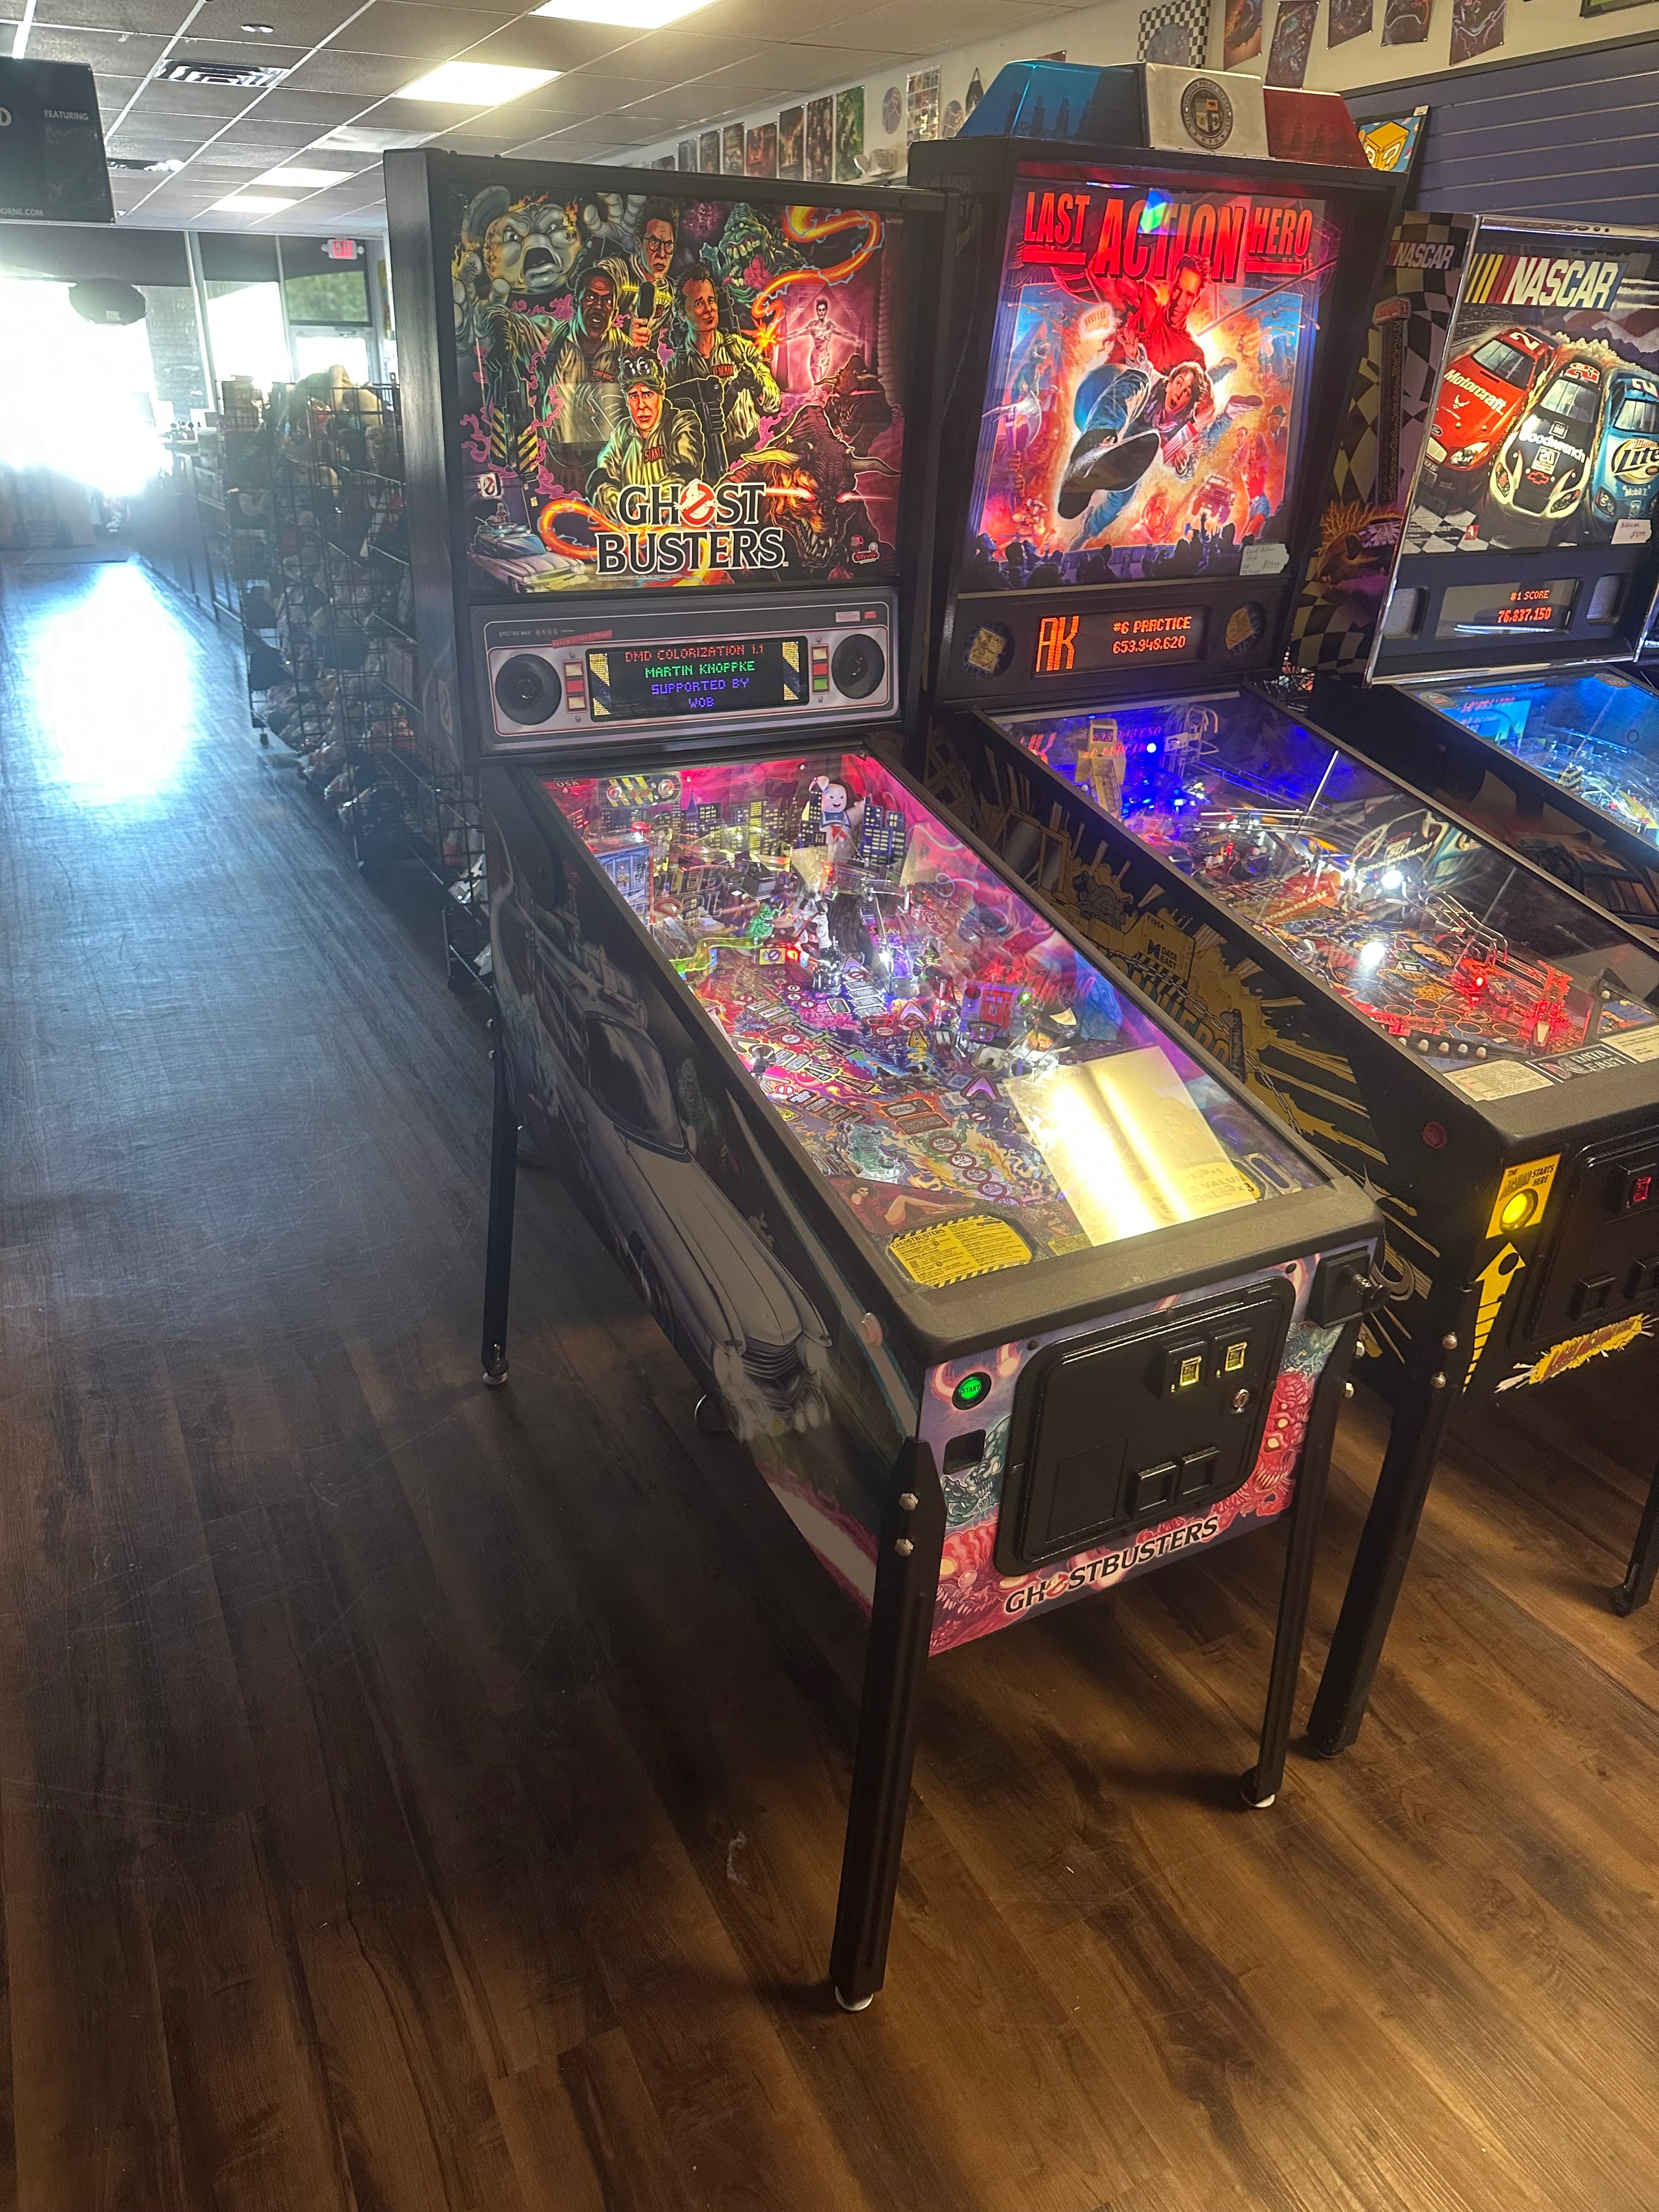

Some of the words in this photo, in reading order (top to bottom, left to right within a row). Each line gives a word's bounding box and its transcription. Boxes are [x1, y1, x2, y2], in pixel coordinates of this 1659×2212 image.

[44, 109, 89, 121] FEATURING
[0, 207, 44, 217] ORNE.COM
[1024, 191, 1091, 245] LAST
[1094, 199, 1245, 282] ACTION
[1249, 207, 1313, 257] HERO
[1395, 242, 1455, 270] NASCAR
[1502, 257, 1620, 309] NASCAR
[1443, 369, 1508, 415] Motorcraft
[618, 478, 767, 528] GHOST
[595, 528, 786, 575] BUSTERS
[1509, 591, 1522, 601] #1
[1523, 589, 1550, 600] SCORE
[1113, 621, 1130, 634] #6
[1132, 616, 1192, 633] PRACTICE
[624, 651, 652, 662] DMD
[657, 645, 745, 661] COLORIZATION
[751, 644, 764, 654] 1.1
[645, 664, 693, 678] MARTIN
[651, 679, 726, 695] SUPPORTED
[732, 678, 750, 689] BY
[688, 697, 715, 708] WOB
[1160, 955, 1177, 970] EAST
[1161, 947, 1177, 962] DATA
[1569, 1049, 1612, 1064] DATA
[1583, 1057, 1627, 1072] EAST
[961, 1385, 980, 1394] START
[1005, 1516, 1220, 1614] GHOSTBUSTERS
